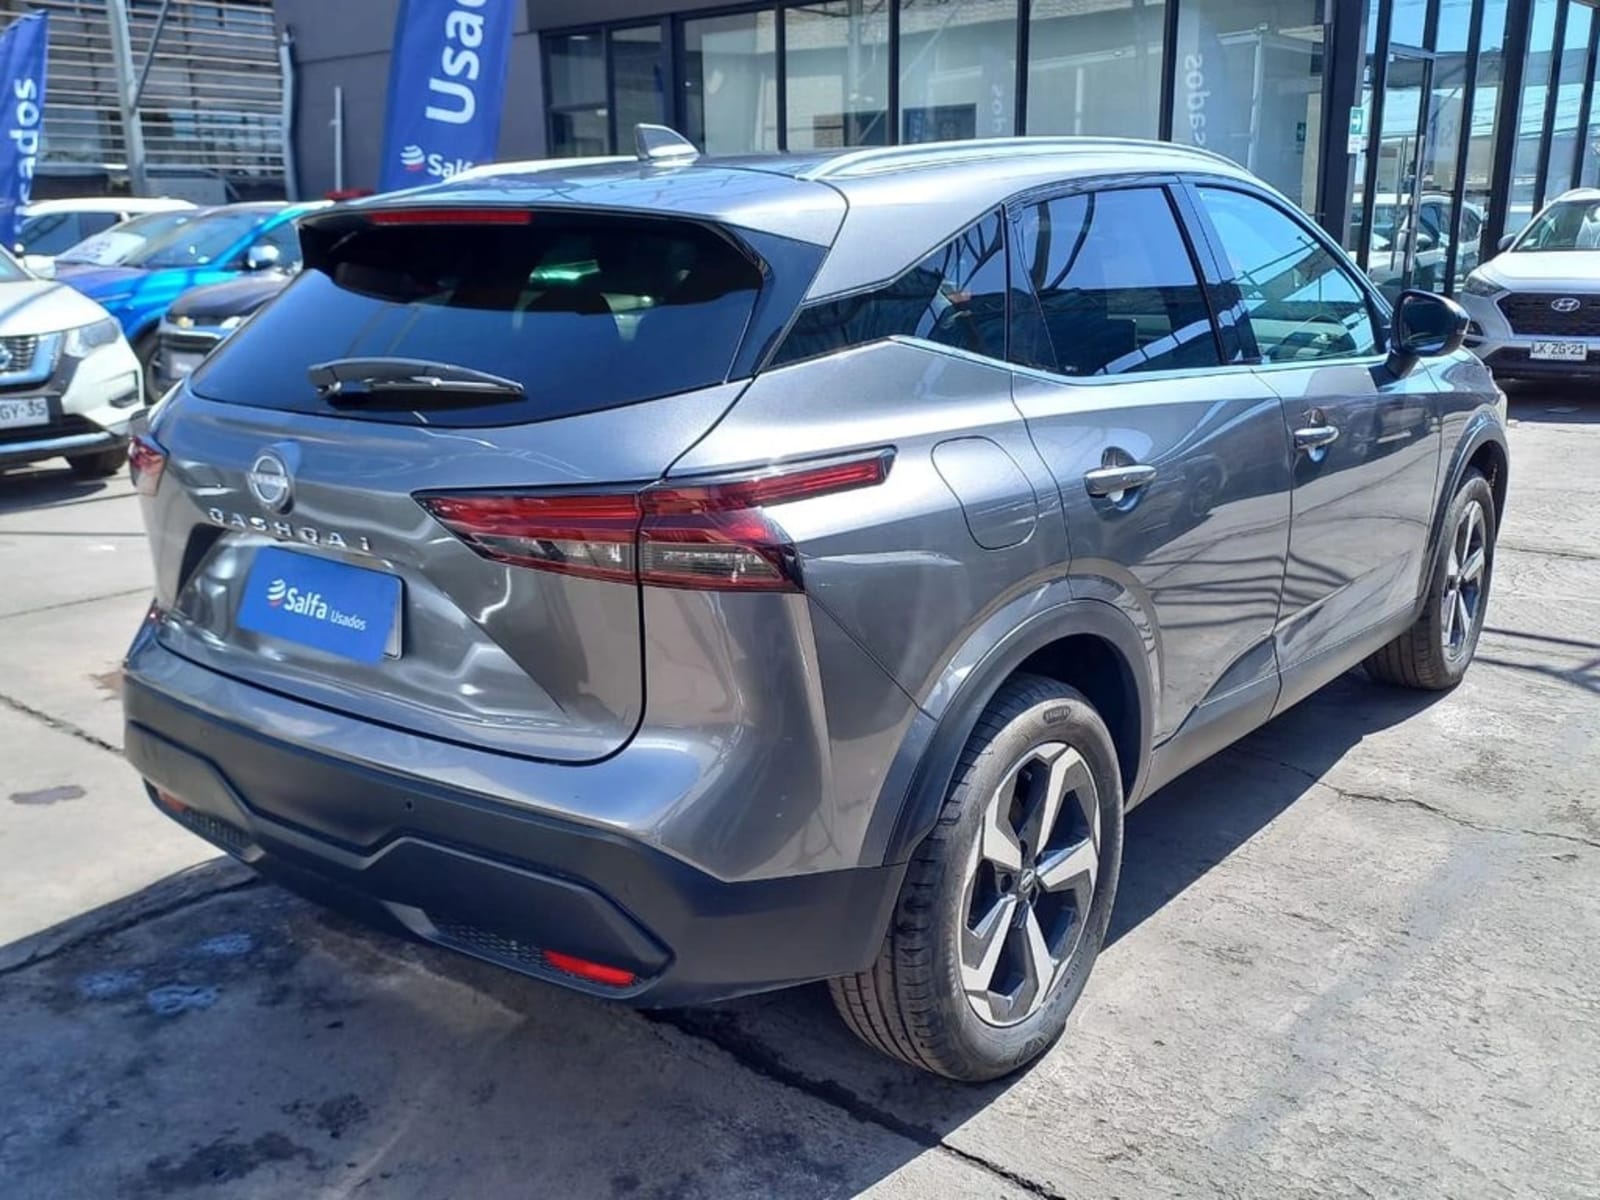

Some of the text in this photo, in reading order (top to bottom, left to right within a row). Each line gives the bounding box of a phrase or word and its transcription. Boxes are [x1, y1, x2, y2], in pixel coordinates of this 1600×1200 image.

[425, 0, 487, 124] Usa
[209, 508, 370, 551] QASHQAI
[284, 587, 367, 631] Salfa Usados
